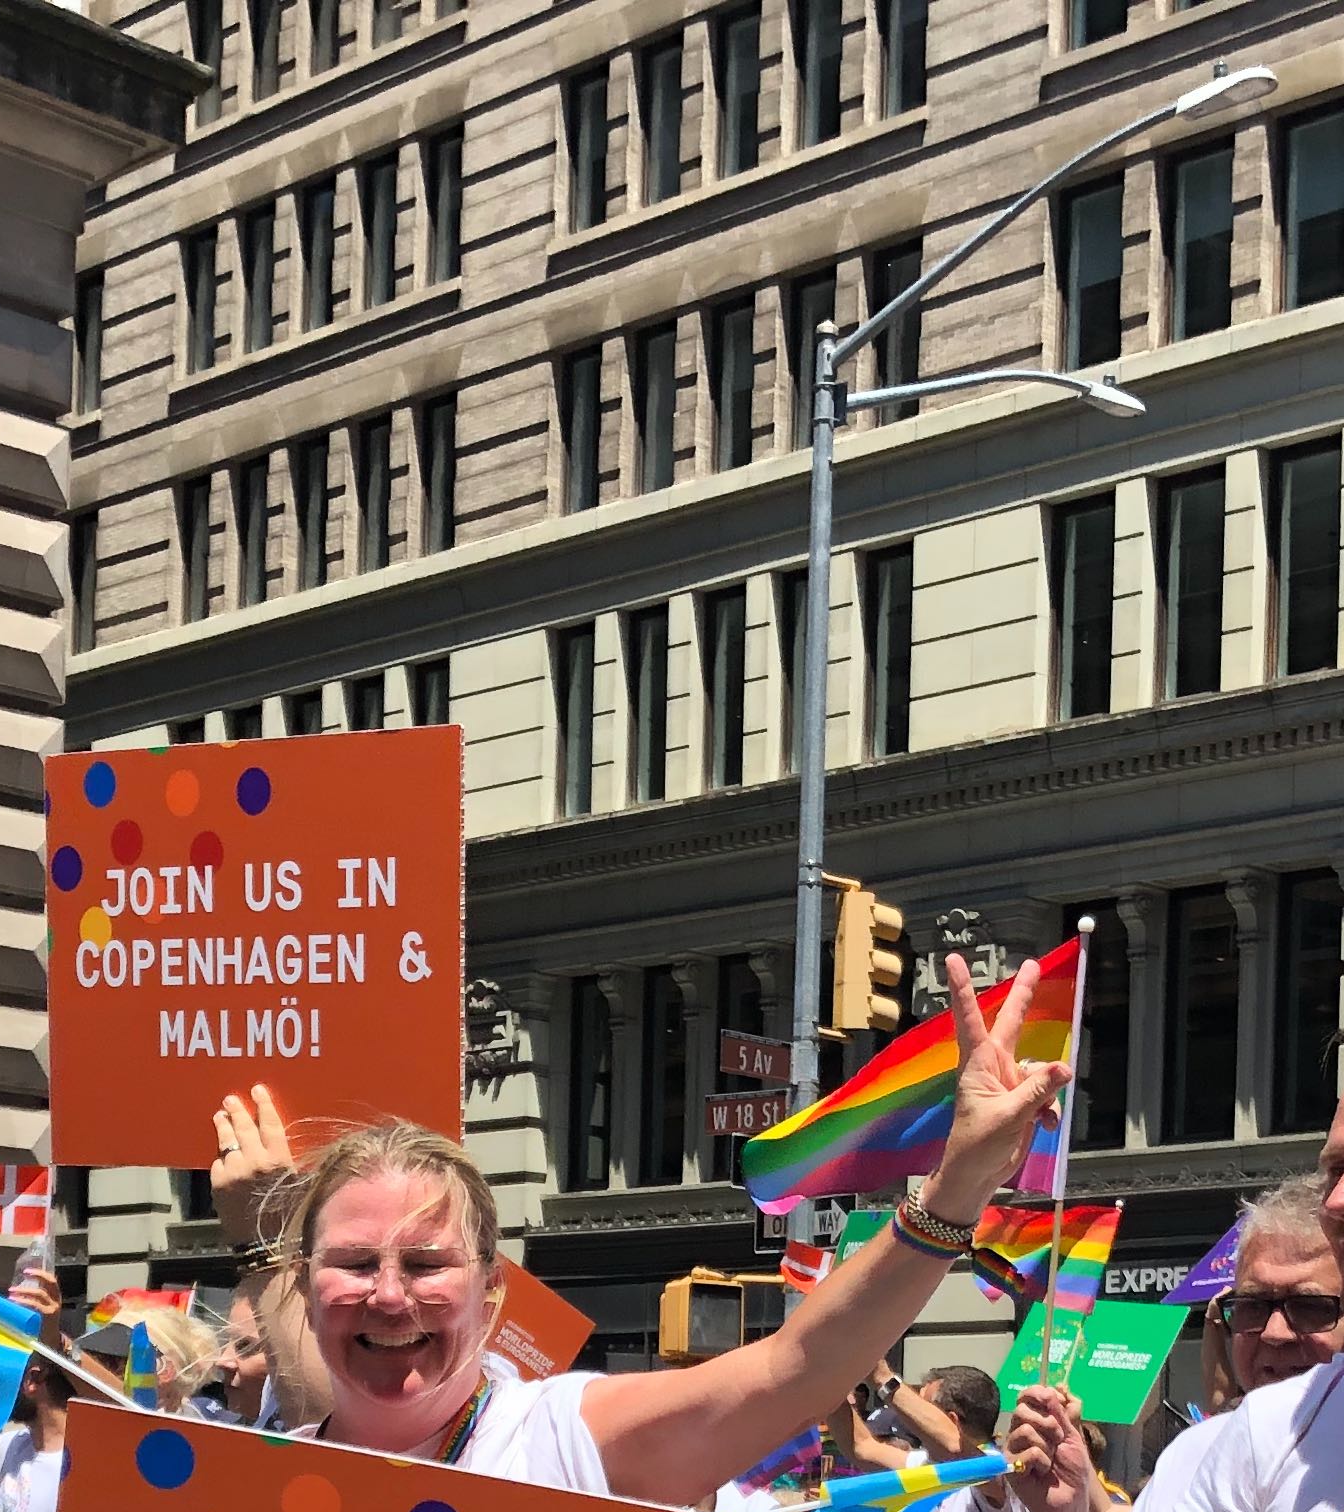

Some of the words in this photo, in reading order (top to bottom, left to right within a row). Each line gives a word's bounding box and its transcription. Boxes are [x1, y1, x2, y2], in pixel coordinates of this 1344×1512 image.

[101, 864, 215, 917] JOIN
[244, 859, 302, 912] US
[337, 856, 397, 908] IN
[75, 933, 365, 988] COPENHAGEN
[398, 931, 433, 983] &
[159, 997, 321, 1058] MALMÖ!
[738, 1045, 748, 1071] 5
[753, 1049, 773, 1075] Av
[713, 1106, 727, 1130] W
[735, 1103, 753, 1129] 18
[762, 1101, 779, 1126] St
[818, 1211, 841, 1233] WAY
